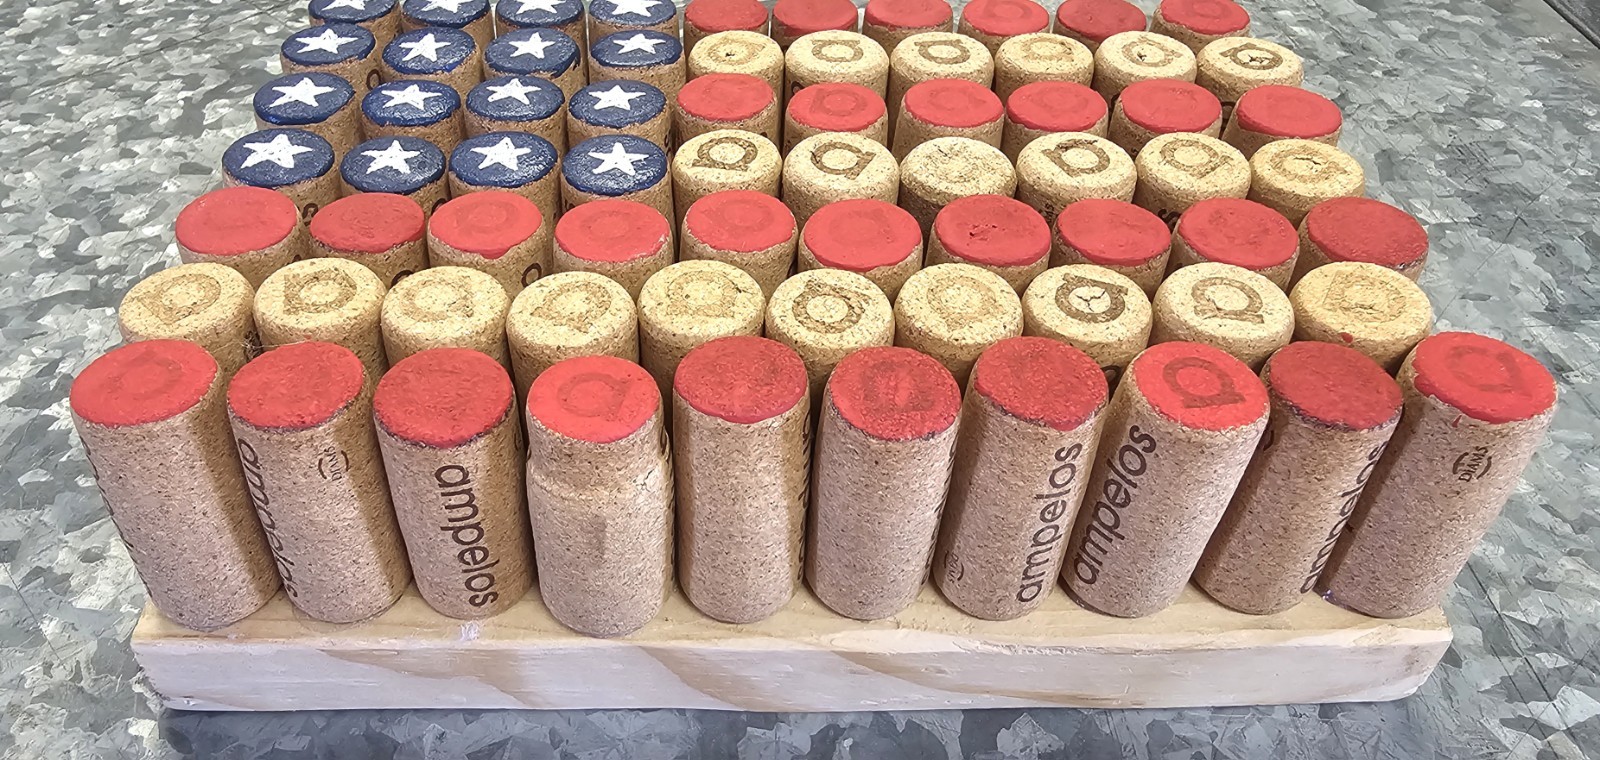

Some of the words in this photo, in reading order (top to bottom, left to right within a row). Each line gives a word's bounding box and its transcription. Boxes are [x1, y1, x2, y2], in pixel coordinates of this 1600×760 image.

[434, 464, 501, 608] ampelos
[1016, 442, 1083, 603] ampelos
[1073, 424, 1157, 586] ampelos
